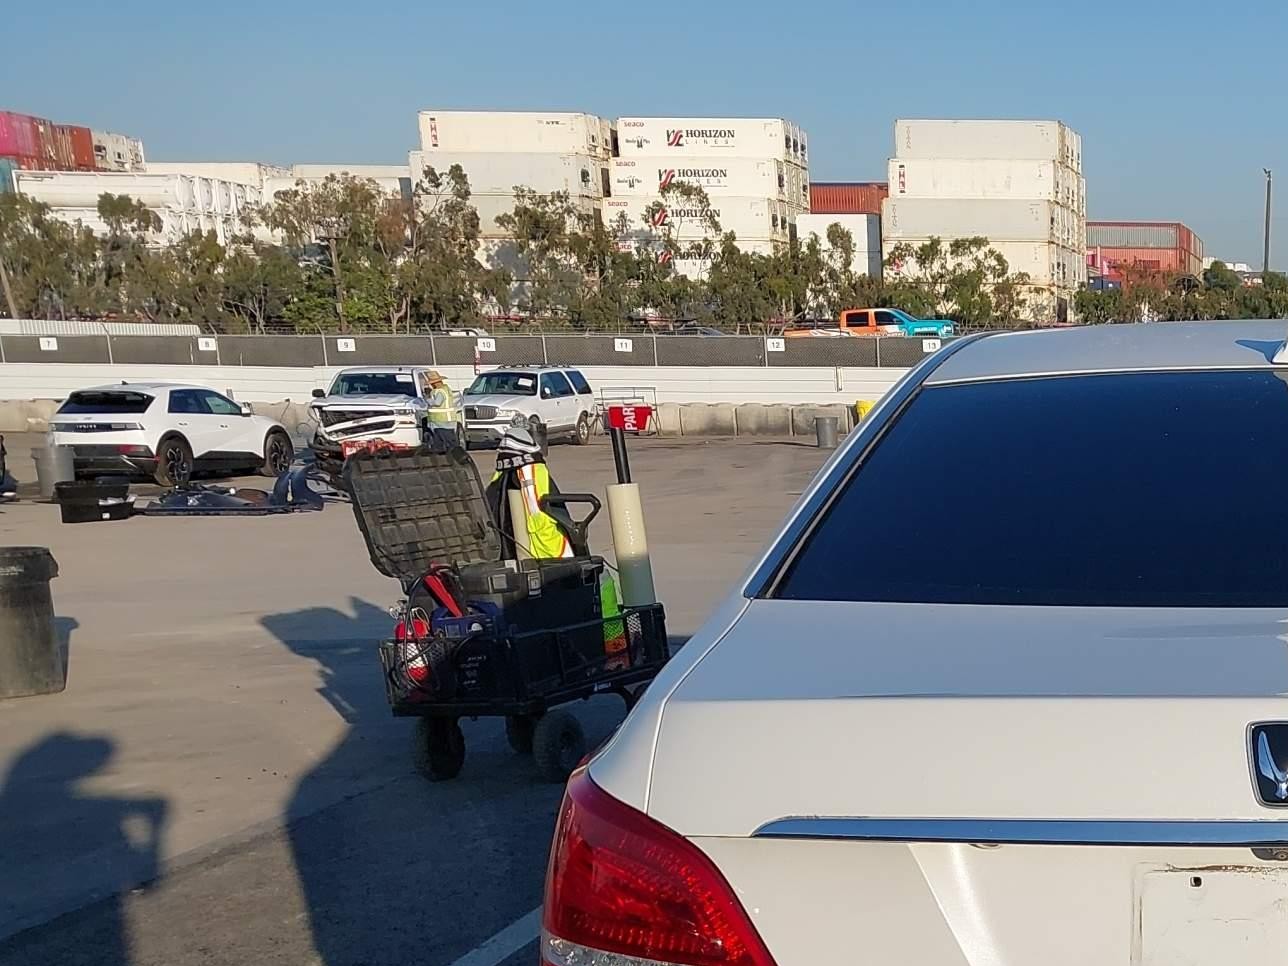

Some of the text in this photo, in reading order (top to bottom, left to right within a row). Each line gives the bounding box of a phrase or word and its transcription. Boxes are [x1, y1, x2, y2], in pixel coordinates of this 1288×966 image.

[624, 120, 645, 128] seaco
[685, 129, 735, 138] HORIZON
[615, 160, 636, 168] seaco
[677, 168, 727, 177] HORIZON
[670, 208, 721, 217] HORIZON
[481, 341, 491, 349] 10
[619, 342, 628, 350] 11
[771, 341, 782, 349] 12
[927, 341, 937, 350] 13
